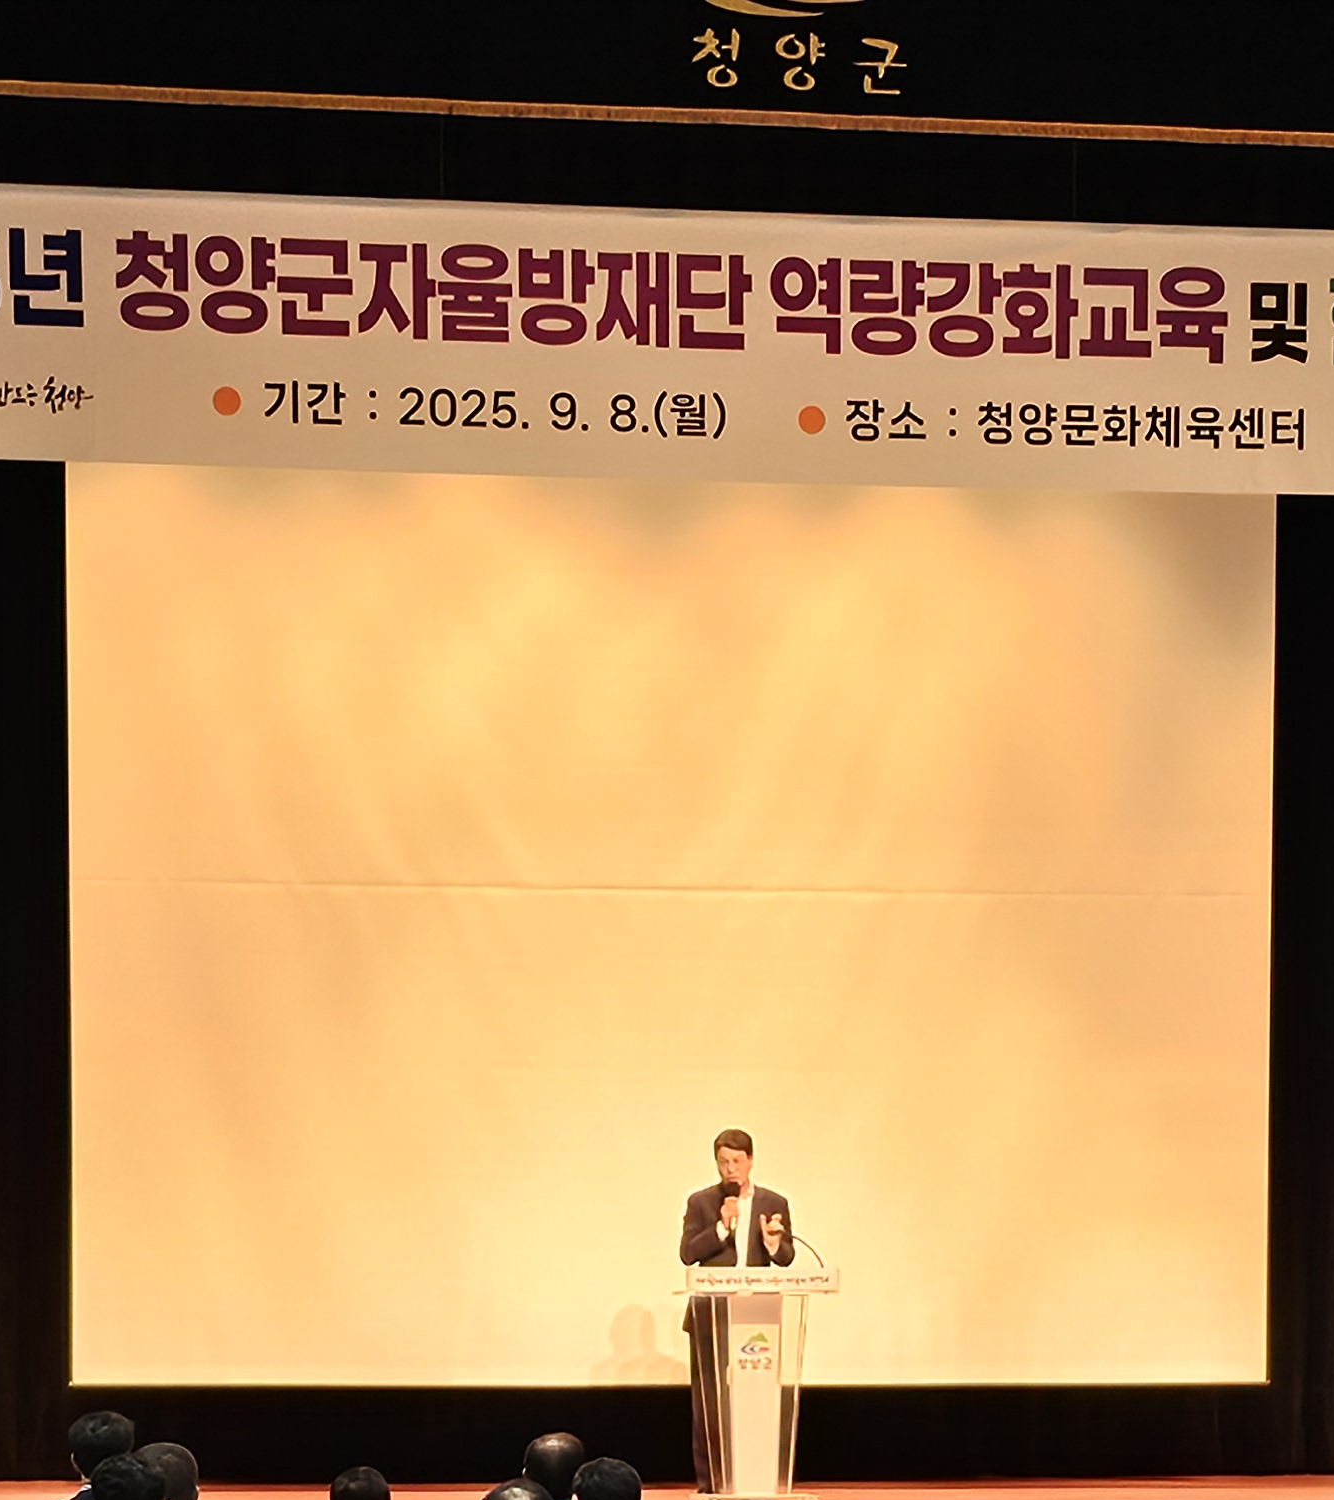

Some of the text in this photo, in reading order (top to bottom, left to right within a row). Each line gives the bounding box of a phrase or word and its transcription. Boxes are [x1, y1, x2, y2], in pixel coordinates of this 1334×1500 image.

[691, 27, 908, 95] 청양군
[113, 229, 754, 354] 청양군자율방재단
[769, 253, 1227, 366] 역량강화교육
[1248, 288, 1311, 366] 및
[264, 380, 346, 426] 기간
[398, 387, 531, 431] 2025.
[549, 391, 591, 433] 9.
[609, 390, 727, 440] 8.(월)
[845, 398, 929, 443] 장소
[976, 401, 1307, 451] 청양문화체육센터
